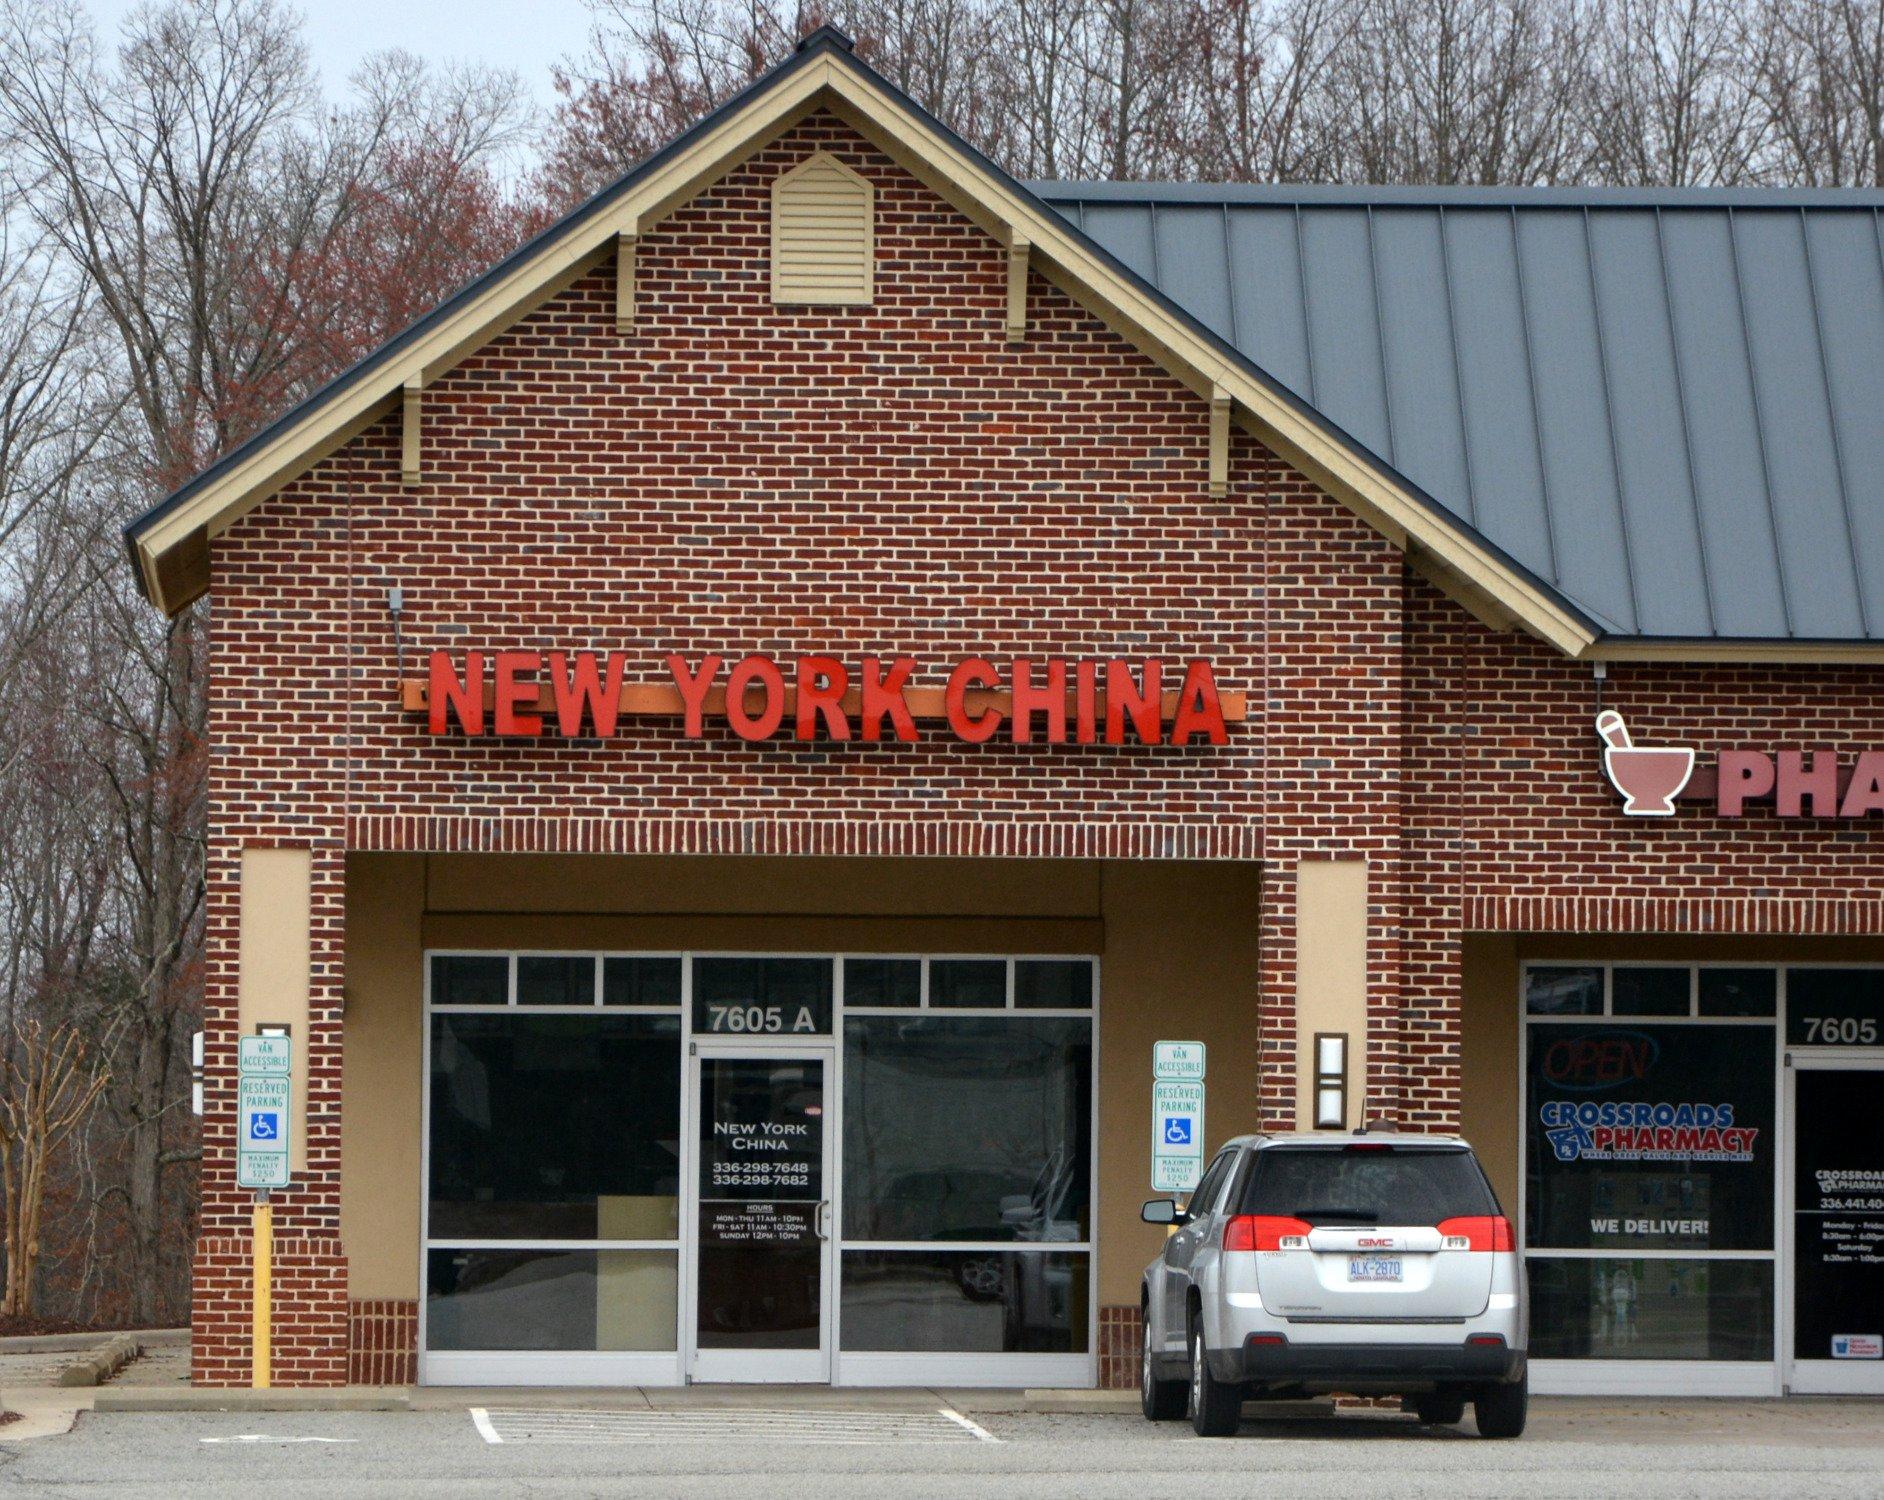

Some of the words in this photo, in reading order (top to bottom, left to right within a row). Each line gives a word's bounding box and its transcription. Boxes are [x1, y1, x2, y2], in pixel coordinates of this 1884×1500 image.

[429, 651, 627, 738] NEW
[666, 654, 921, 743] YORK
[944, 657, 1230, 746] CHINA
[709, 1006, 782, 1032] 7605
[792, 1006, 816, 1032] A
[1803, 1017, 1877, 1044] 7605
[258, 1044, 273, 1053] VAN
[1172, 1050, 1187, 1059] VAN
[1543, 1039, 1649, 1081] OPEN
[243, 1057, 287, 1067] ACCESSIBLE
[1158, 1062, 1201, 1072] ACCESSIBLE
[242, 1083, 287, 1094] RESERVED
[1158, 1088, 1200, 1099] RESERVED
[246, 1097, 283, 1108] PARKING
[1160, 1101, 1197, 1112] PARKING
[1540, 1102, 1735, 1128] CROSSROADS
[713, 1122, 756, 1135] NEW
[761, 1122, 808, 1135] YORK
[732, 1138, 789, 1150] CHINA
[1594, 1127, 1759, 1152] PHARMACY
[713, 1162, 809, 1173] 336-298-7648
[712, 1175, 808, 1186] 336-298-7682
[1838, 1180, 1884, 1189] PHARMA
[746, 1204, 774, 1212] HOURS
[1591, 1219, 1619, 1234] WE
[1624, 1219, 1709, 1235] DELIVER!
[1357, 1238, 1393, 1247] GMC
[1350, 1262, 1400, 1276] ALK-2870
